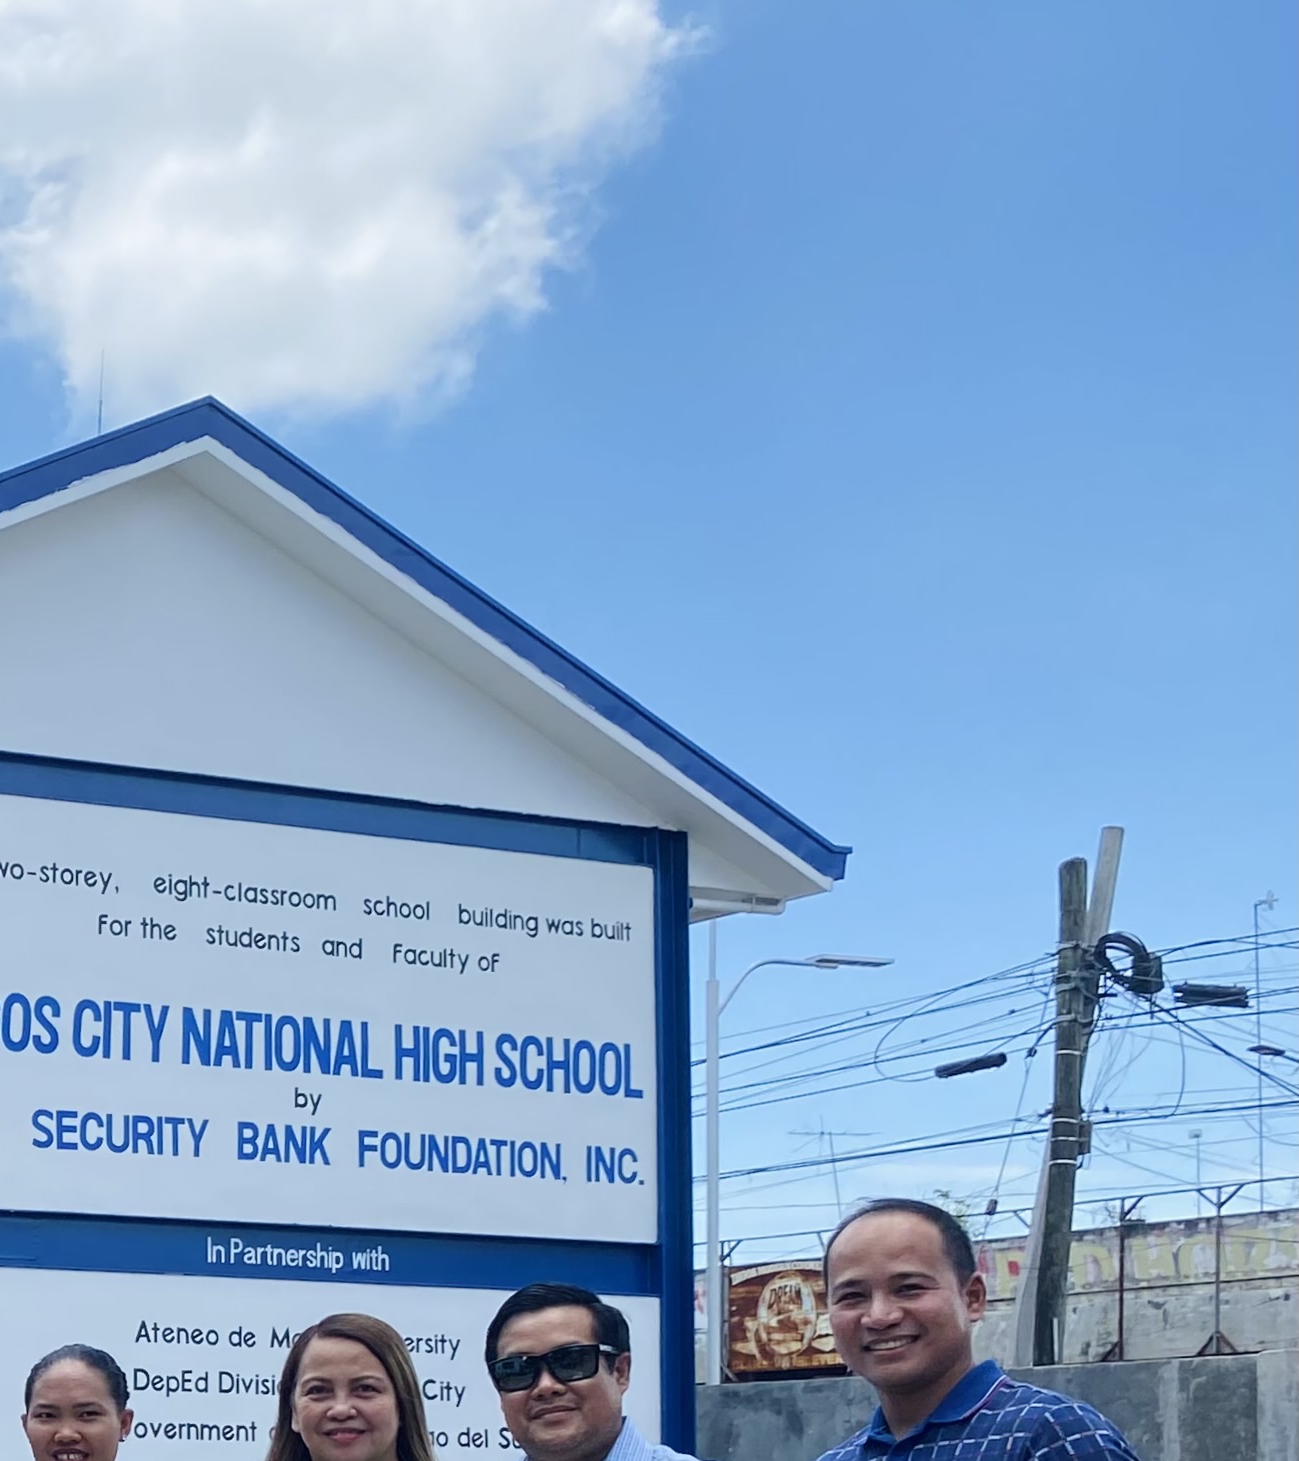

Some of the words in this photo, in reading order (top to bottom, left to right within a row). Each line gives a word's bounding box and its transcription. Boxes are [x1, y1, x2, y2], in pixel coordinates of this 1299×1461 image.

[153, 873, 337, 912] eight-classroom
[363, 895, 430, 921] school
[458, 903, 539, 939] building
[545, 918, 584, 937] was
[590, 917, 632, 942] built
[139, 917, 177, 941] the
[205, 924, 301, 953] students
[321, 937, 363, 960] and
[72, 998, 170, 1063] CITY
[181, 1006, 384, 1080] NATIONAL
[394, 1023, 485, 1087] HIGH
[494, 1033, 644, 1100] SCHOOL
[294, 1086, 323, 1116] by
[31, 1108, 210, 1158] SECURITY
[237, 1121, 332, 1166] BANK
[358, 1129, 567, 1182] FOUNDATION,
[586, 1145, 645, 1186] INC.
[207, 1236, 226, 1264] In
[229, 1237, 344, 1274] Partnership
[352, 1245, 390, 1271] with
[135, 1320, 220, 1346] Ateneo
[228, 1325, 257, 1348] de
[403, 1334, 461, 1361] ersity
[133, 1367, 209, 1398] DepEd
[218, 1370, 282, 1397] Divisi
[422, 1378, 466, 1408] City
[133, 1420, 259, 1443] overnment
[457, 1426, 489, 1449] del
[497, 1426, 525, 1449] Su
